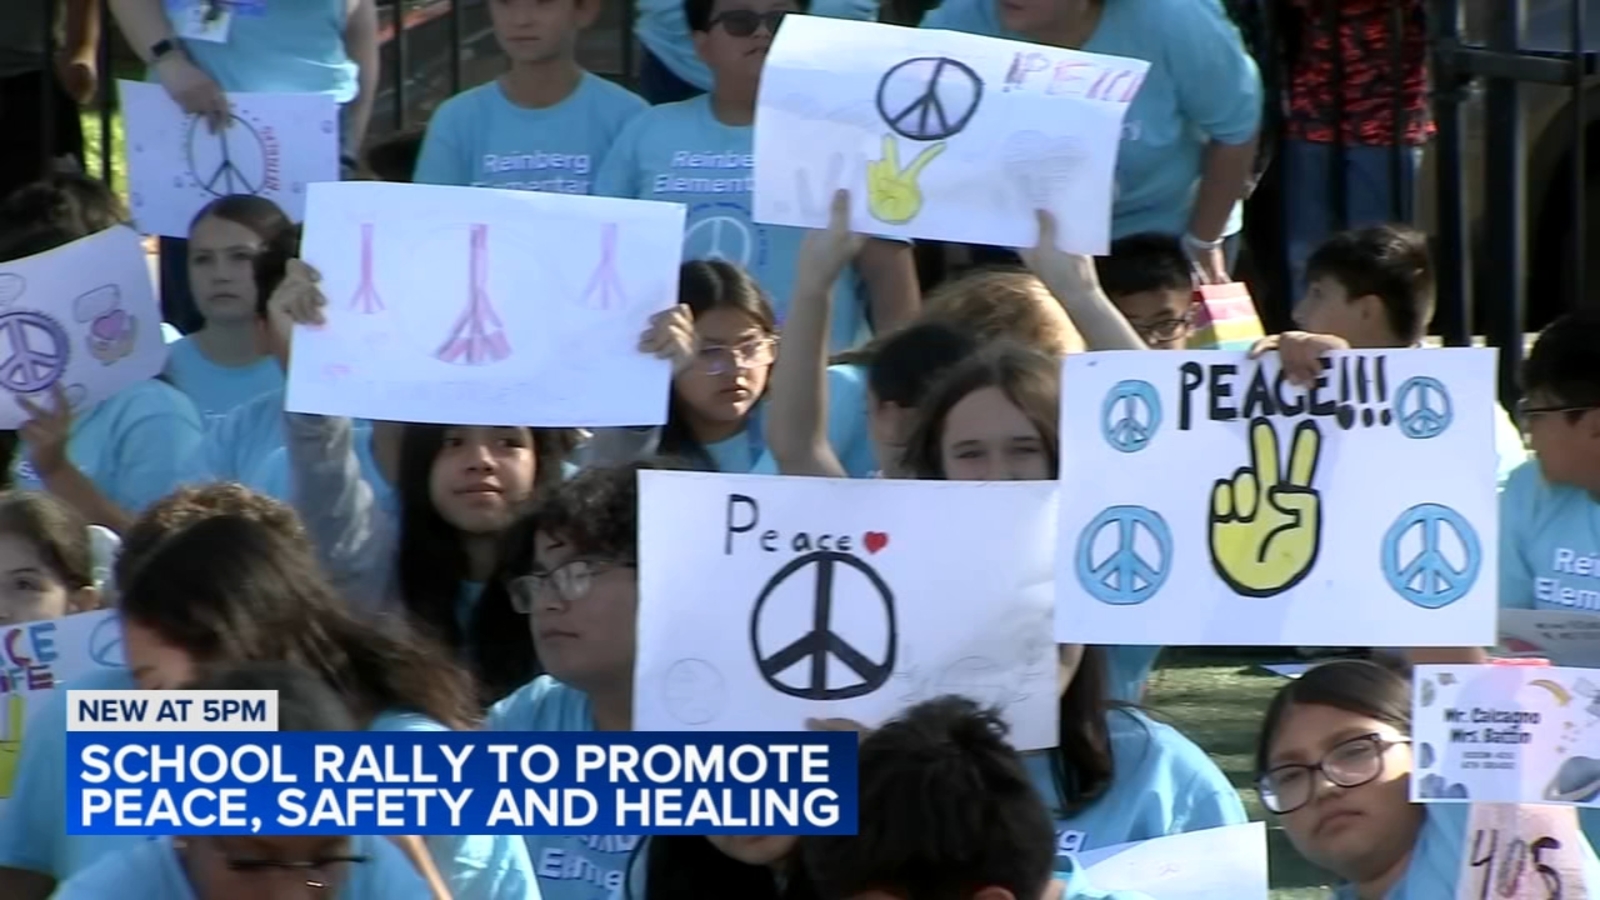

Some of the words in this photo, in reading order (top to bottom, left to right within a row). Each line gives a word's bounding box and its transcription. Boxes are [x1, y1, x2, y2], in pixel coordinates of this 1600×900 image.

[482, 150, 591, 174] Reinberg
[672, 150, 754, 168] Reinbe
[725, 493, 852, 555] Peace
[1553, 548, 1600, 578] Rei
[1534, 577, 1600, 610] Elem
[0, 622, 59, 668] CE
